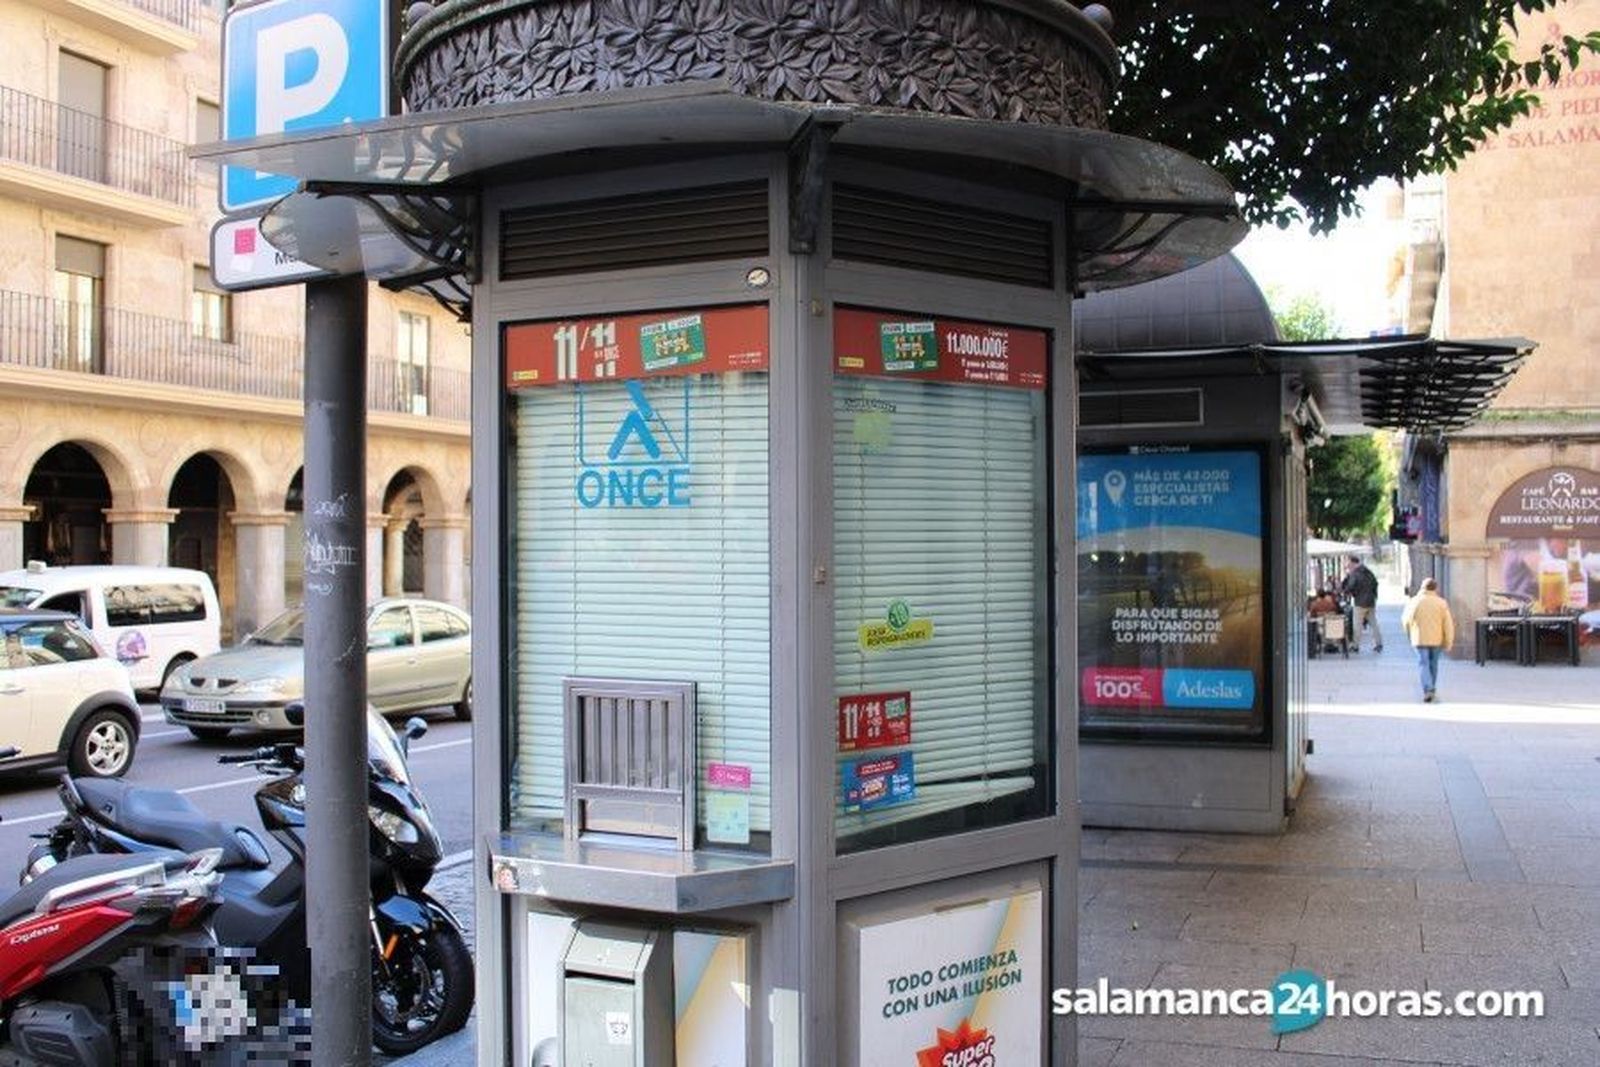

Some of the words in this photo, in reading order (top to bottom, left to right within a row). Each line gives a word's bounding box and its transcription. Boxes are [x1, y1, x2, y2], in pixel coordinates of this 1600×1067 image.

[256, 12, 349, 180] P
[1164, 470, 1180, 482] DE
[577, 468, 691, 509] ONCE
[1134, 482, 1230, 494] ESPECIALISTAS
[1134, 494, 1177, 506] CERCA
[1180, 494, 1196, 505] DE
[1198, 493, 1213, 505] TI
[1500, 515, 1565, 525] RESTAURANTE
[1116, 607, 1147, 620] PARA
[1151, 607, 1178, 620] QUE
[1181, 607, 1220, 620] SIGAS
[1112, 619, 1202, 632] DISFRUTANDO
[1205, 620, 1223, 633] DE
[1116, 631, 1134, 644] LO
[1136, 631, 1218, 644] IMPORTANTE
[1176, 679, 1243, 699] Adeslas
[888, 970, 933, 995] TODO
[938, 949, 1018, 982] COMIENZA
[882, 998, 919, 1019] CON
[924, 988, 958, 1008] UNA
[962, 968, 1022, 999] ILUSIÓN
